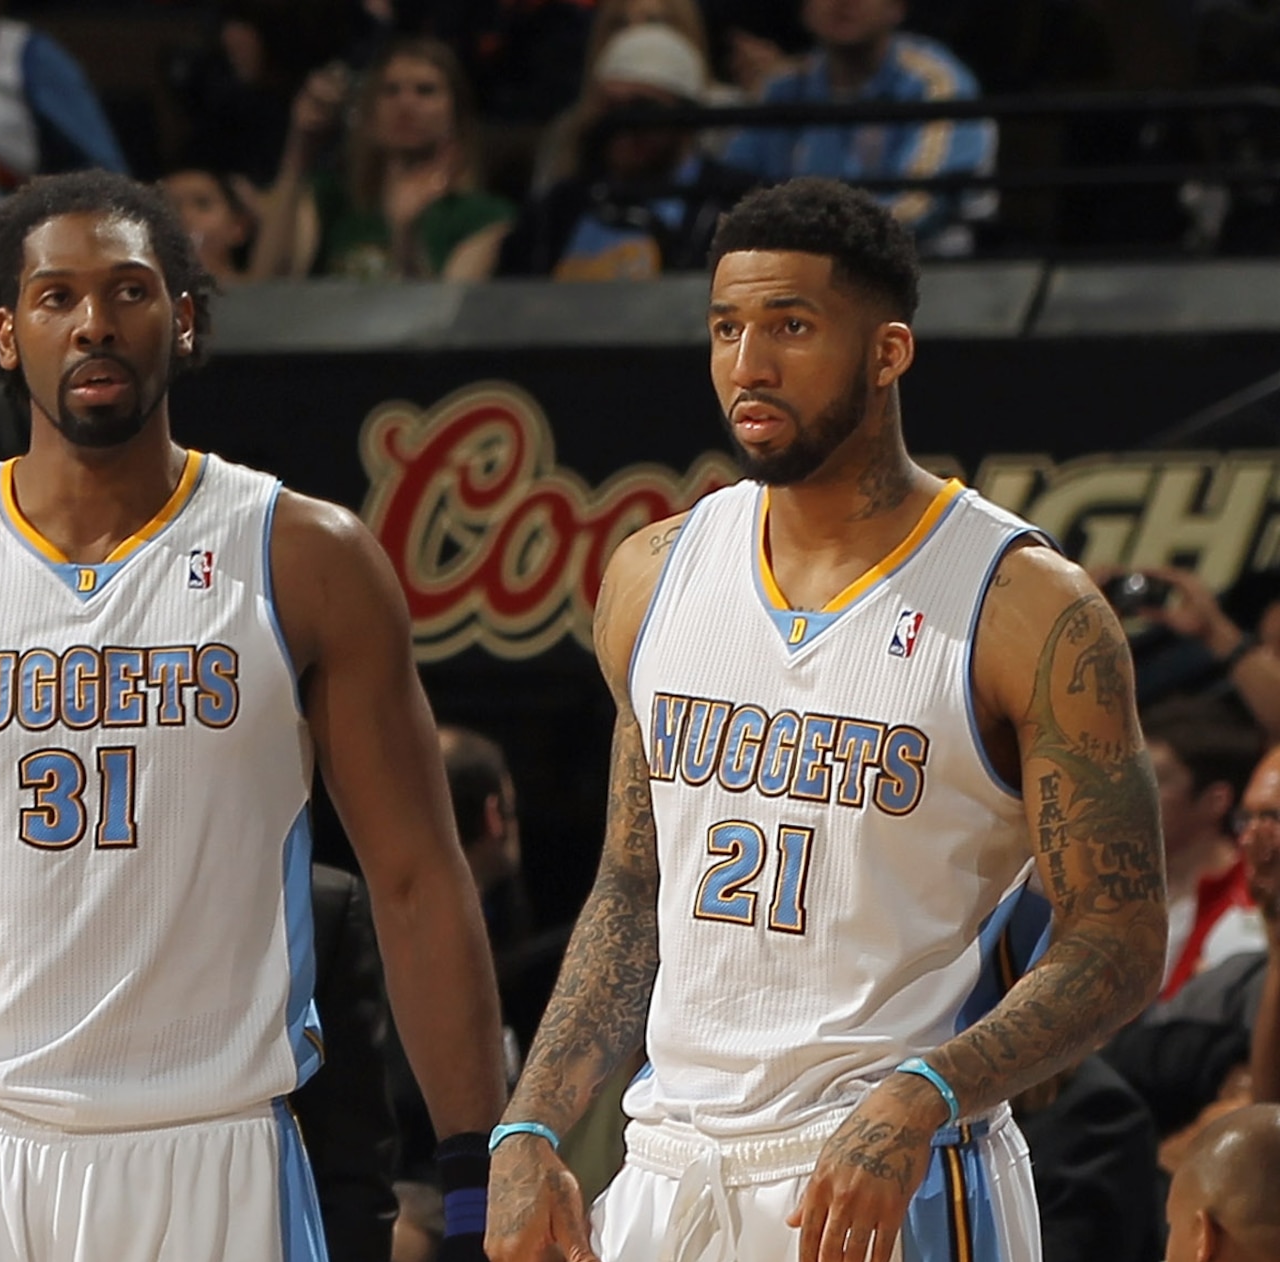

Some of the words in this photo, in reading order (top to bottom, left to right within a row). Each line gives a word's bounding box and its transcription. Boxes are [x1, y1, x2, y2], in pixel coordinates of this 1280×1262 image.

[19, 746, 137, 851] 31
[649, 692, 929, 816] NUGGETS
[693, 819, 814, 934] 21
